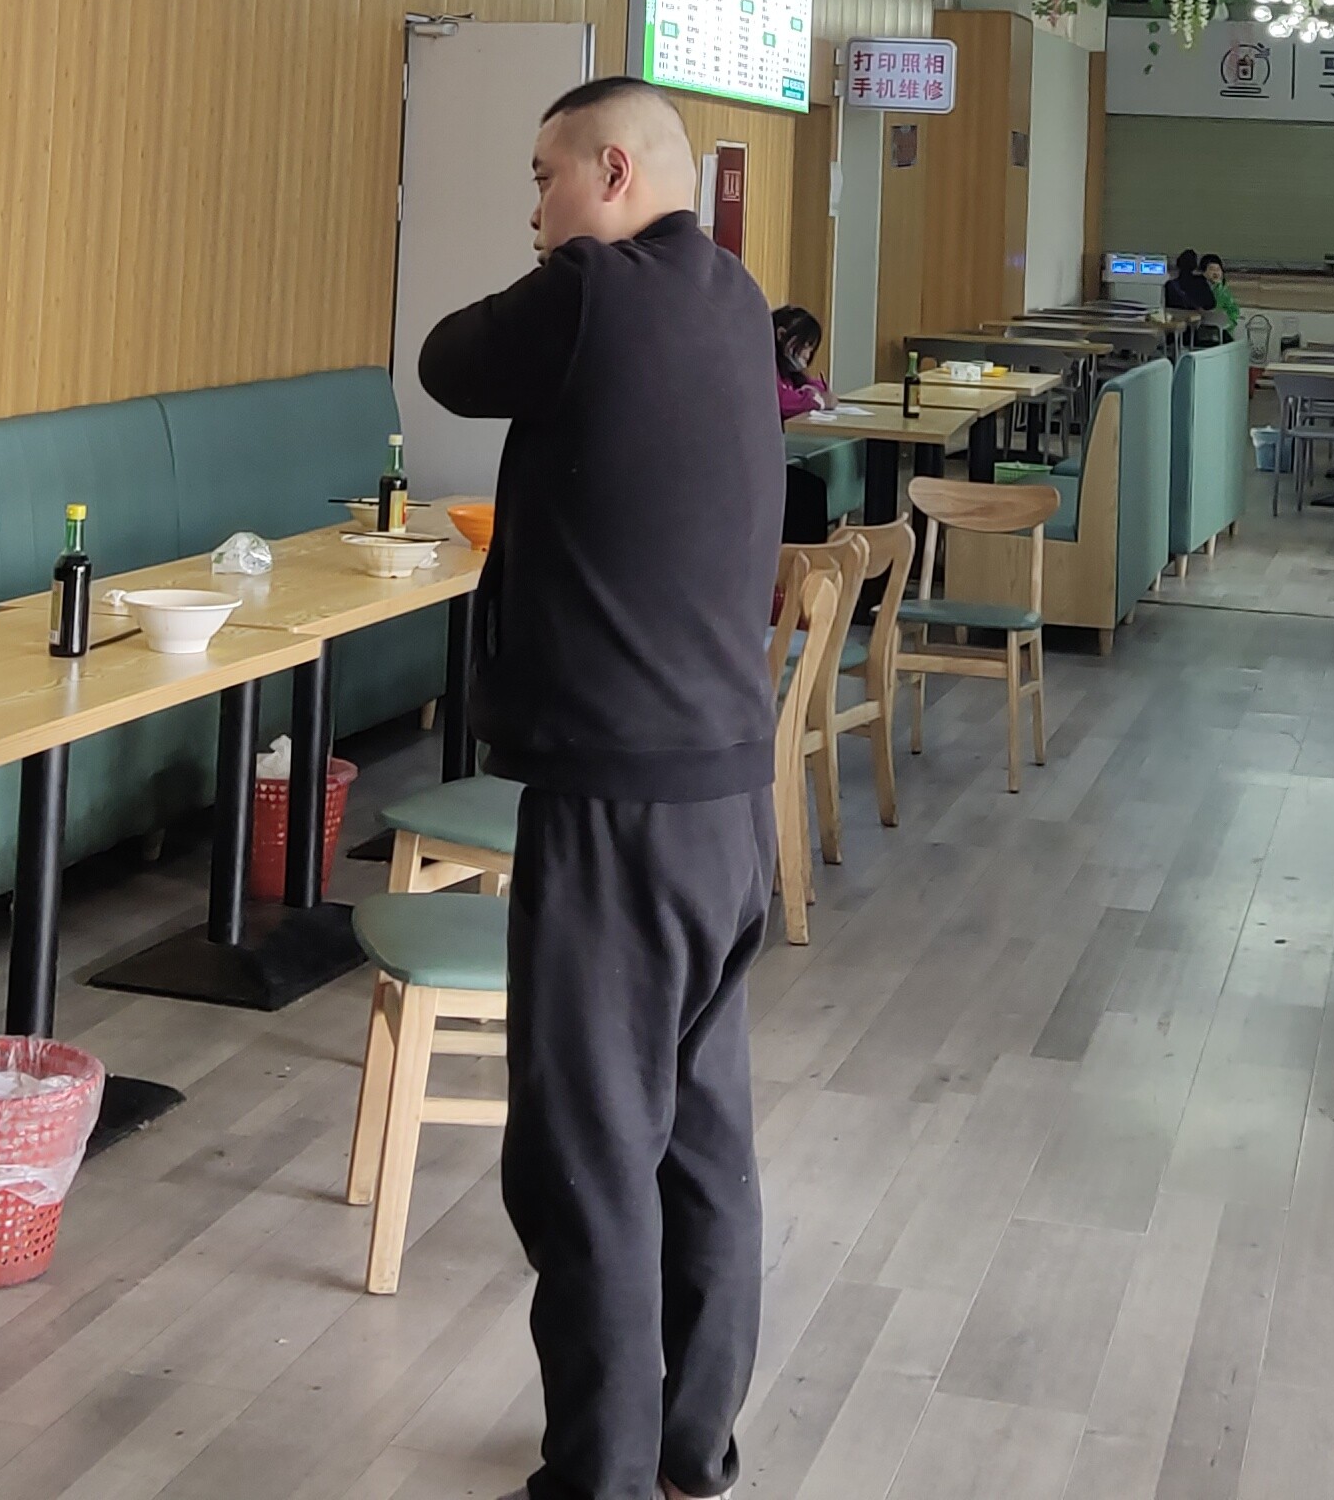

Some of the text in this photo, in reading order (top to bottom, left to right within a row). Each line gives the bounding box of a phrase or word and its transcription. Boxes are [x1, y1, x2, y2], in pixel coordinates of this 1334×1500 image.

[853, 51, 945, 75] 打印照相
[852, 77, 944, 101] 手机维修
